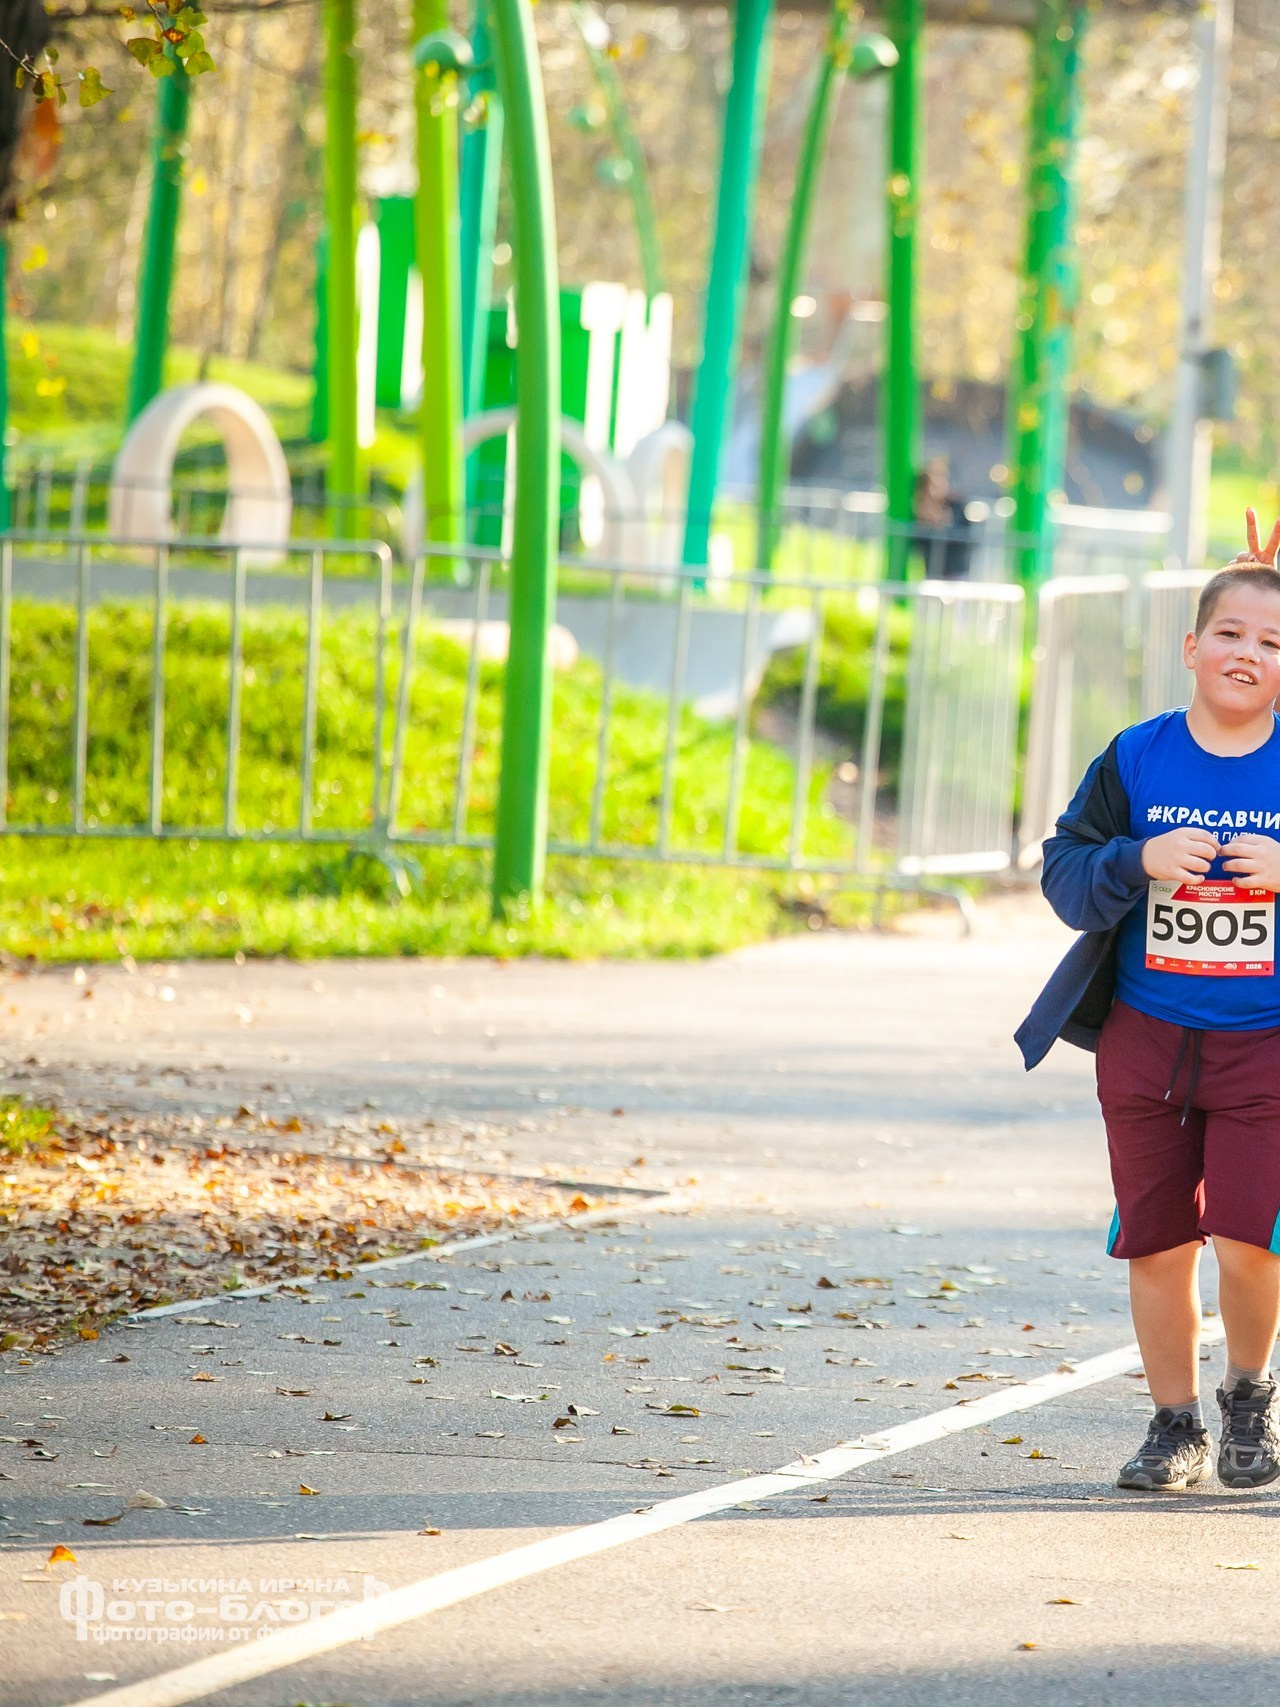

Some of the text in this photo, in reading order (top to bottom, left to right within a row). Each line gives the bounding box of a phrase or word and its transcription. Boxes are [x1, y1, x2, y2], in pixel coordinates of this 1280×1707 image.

[1222, 831, 1256, 842] ПА
[1185, 885, 1235, 893] КРАСНОЯРСКИЕ
[1152, 903, 1268, 947] 5905
